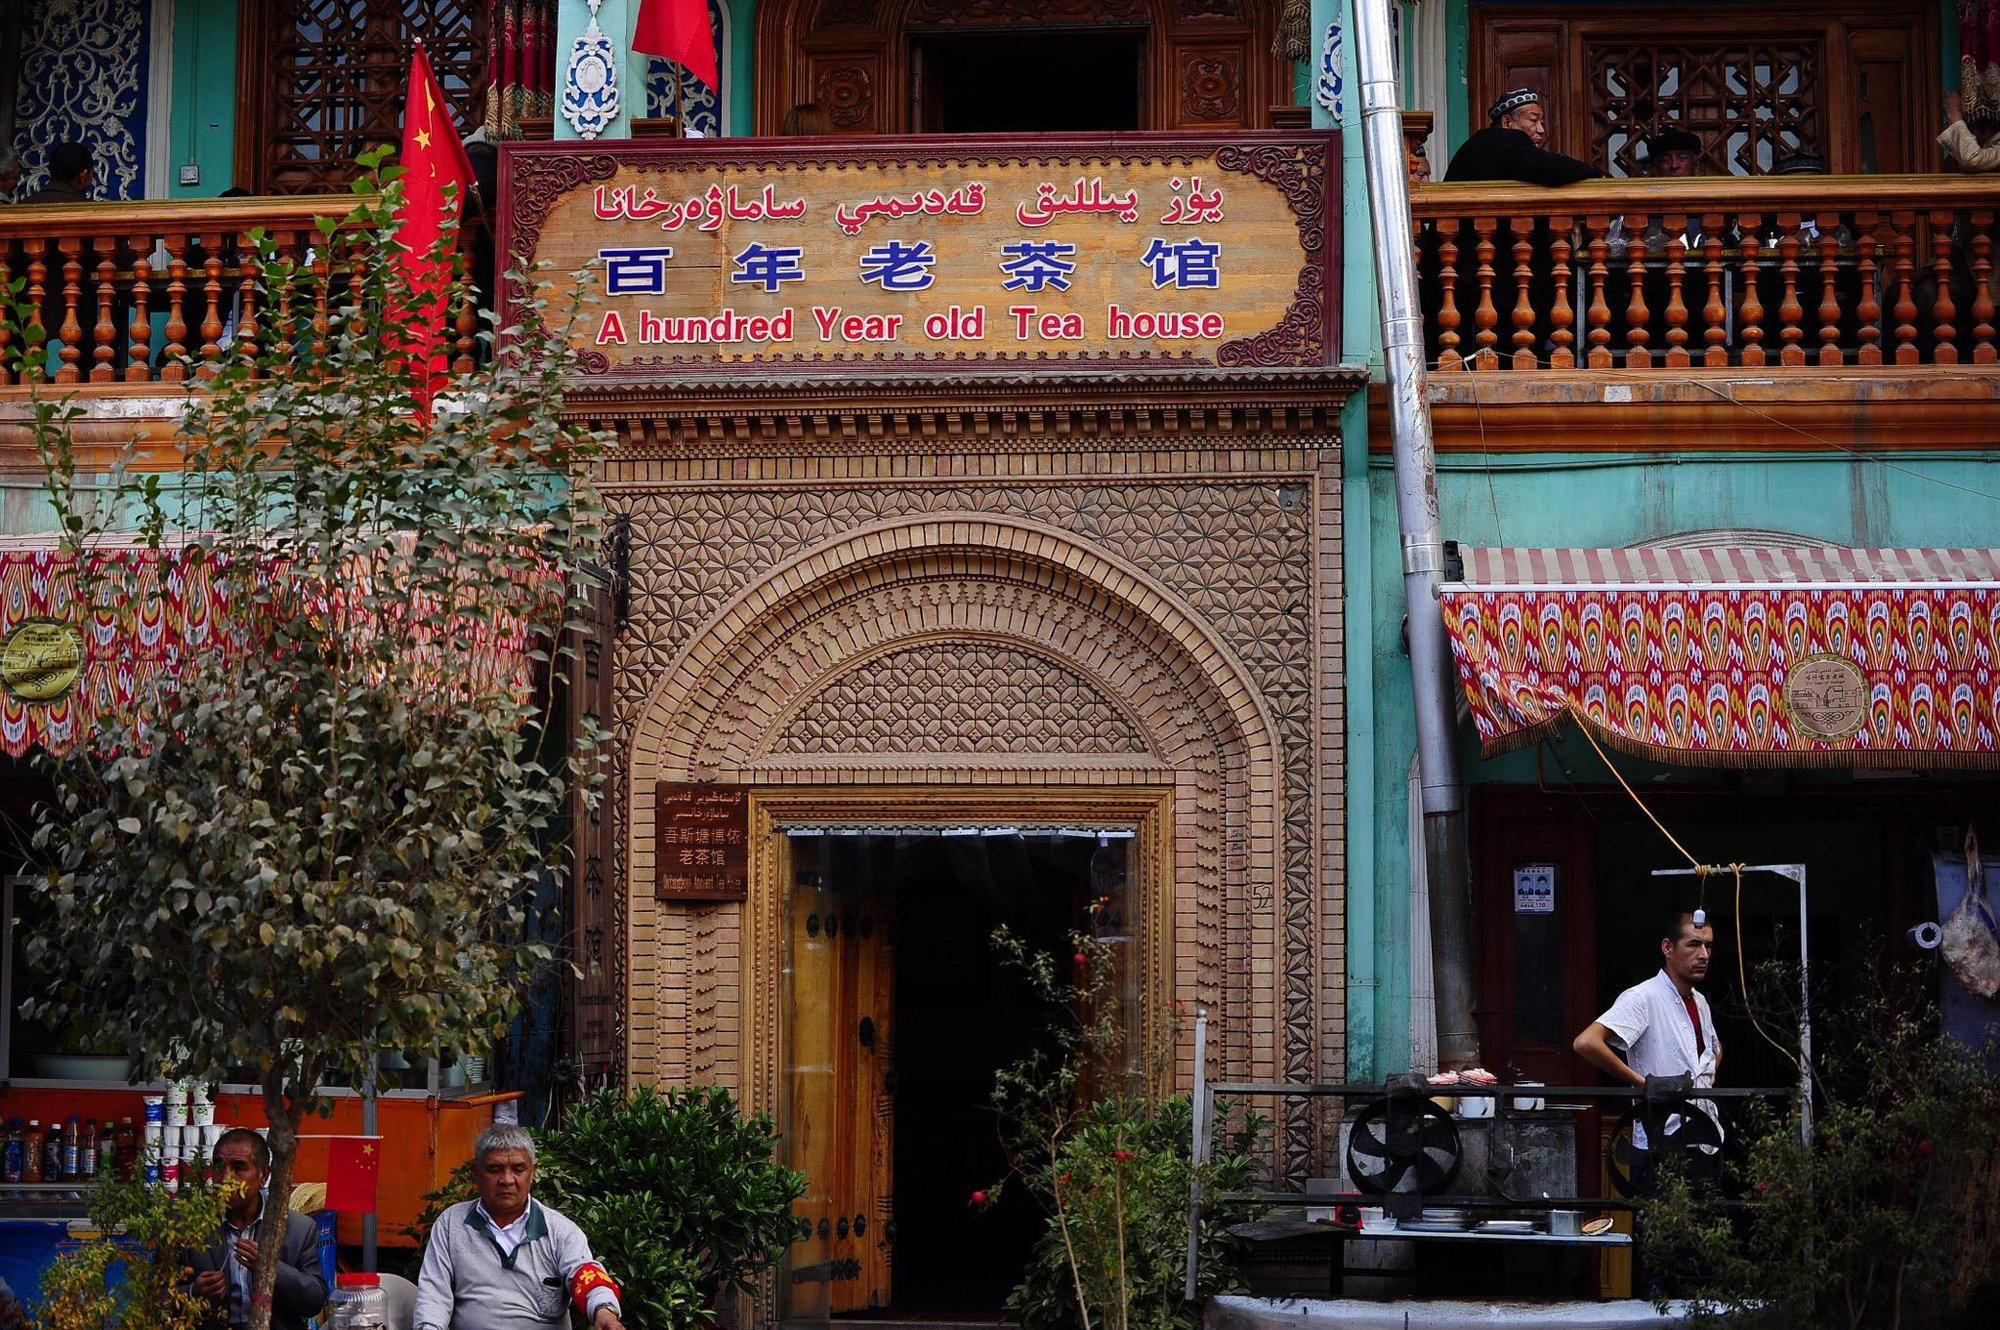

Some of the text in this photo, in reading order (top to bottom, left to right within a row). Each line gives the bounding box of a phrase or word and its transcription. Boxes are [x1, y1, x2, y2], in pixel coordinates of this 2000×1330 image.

[1160, 177, 1223, 224] يۈز
[598, 238, 1221, 295] 百年老茶馆
[596, 304, 1224, 344] A hundred Year old Tea house
[679, 848, 726, 866] 老茶馆
[1252, 884, 1274, 910] 52
